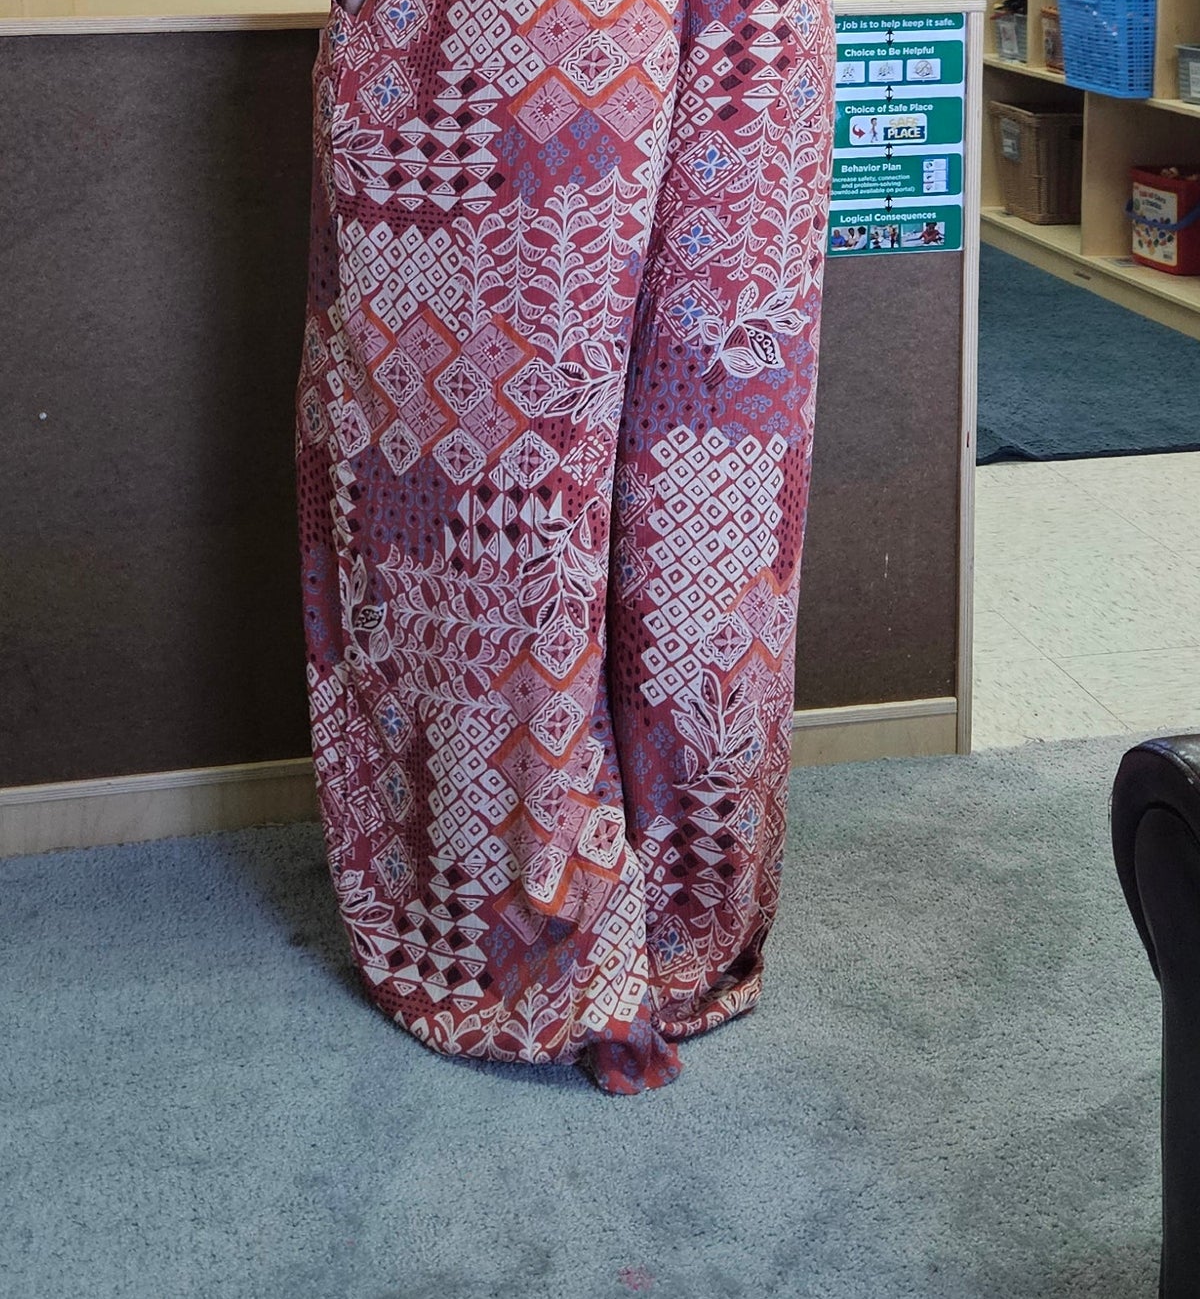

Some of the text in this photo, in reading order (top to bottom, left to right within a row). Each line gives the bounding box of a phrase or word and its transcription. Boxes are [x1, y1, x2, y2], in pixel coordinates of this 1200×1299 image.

[842, 21, 858, 30] job
[860, 20, 868, 28] is
[881, 20, 900, 29] help
[902, 19, 924, 28] keep
[935, 18, 955, 26] safe.
[844, 46, 934, 57] Choice to Be Helpful
[845, 106, 876, 114] Choice
[888, 104, 908, 112] Safe
[910, 103, 934, 111] Place
[888, 117, 918, 127] SAFE
[888, 127, 922, 139] PLACE
[841, 163, 901, 173] Behavior Plan
[840, 212, 937, 223] Logical Consequences
